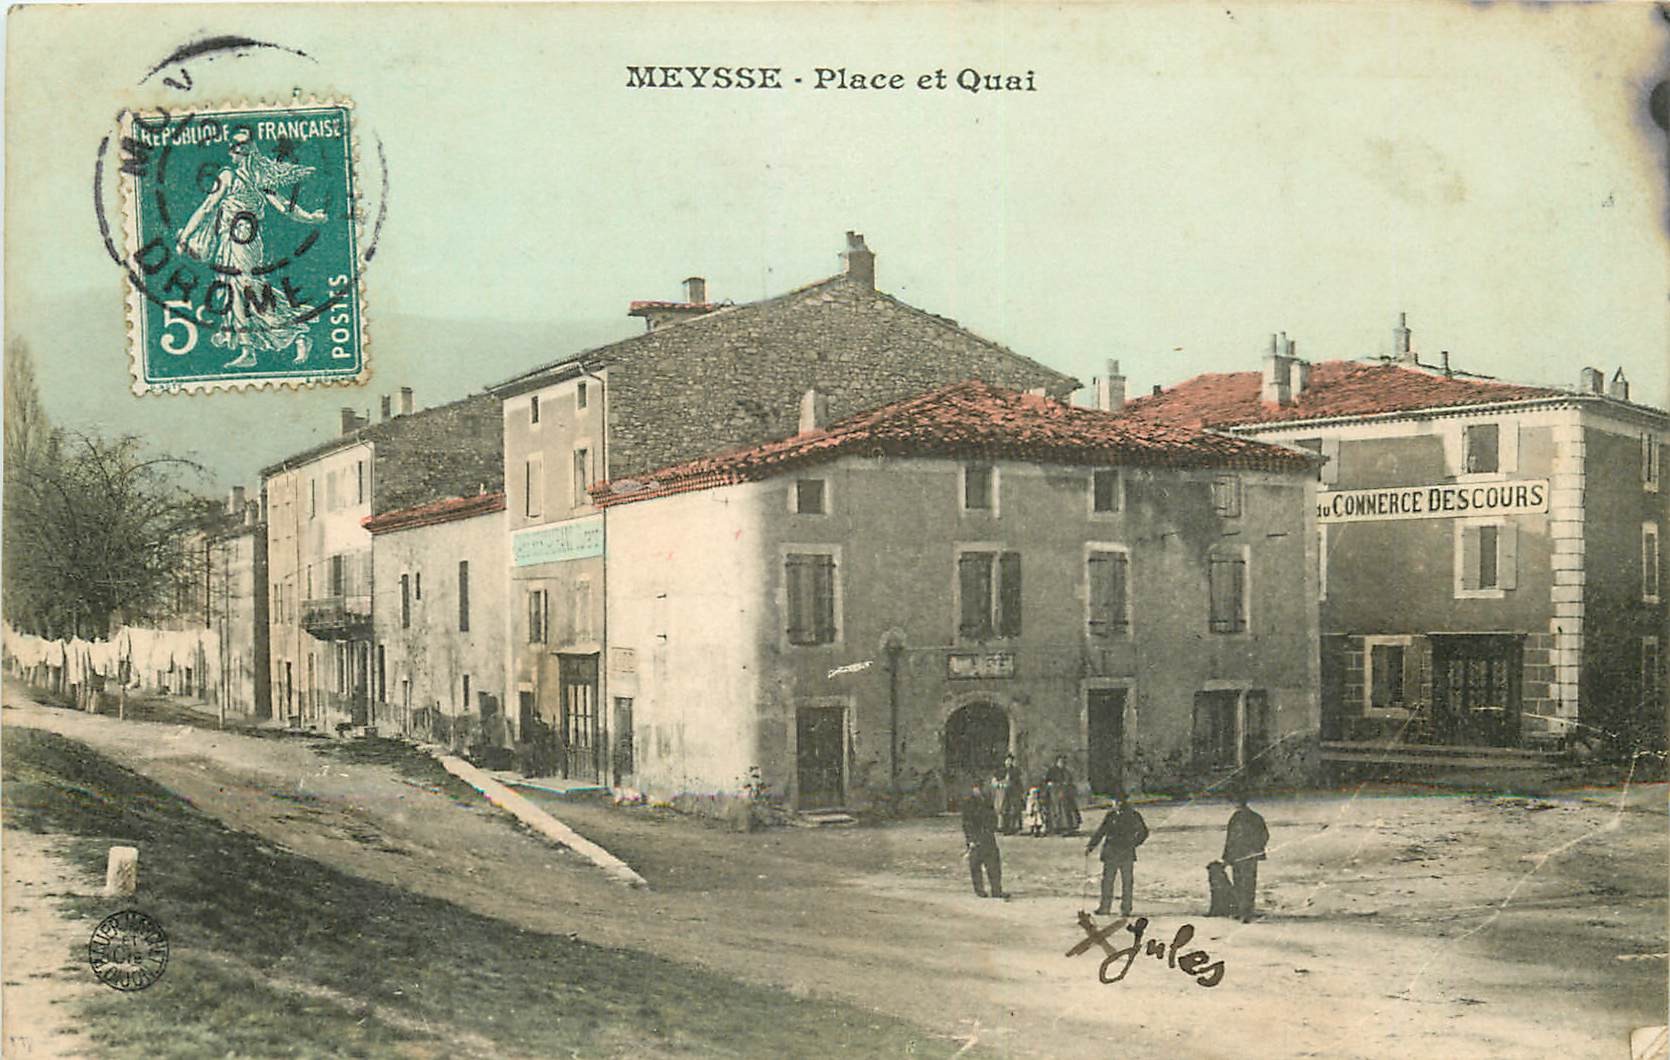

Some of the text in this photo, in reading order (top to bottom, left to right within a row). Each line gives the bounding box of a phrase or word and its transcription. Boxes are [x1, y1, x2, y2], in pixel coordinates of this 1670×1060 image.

[257, 118, 341, 142] FRANÇAISE
[329, 274, 351, 360] POSTES
[1332, 490, 1423, 518] COMMERCE
[1428, 484, 1544, 512] DESCOURS
[1099, 917, 1225, 988] Jules
